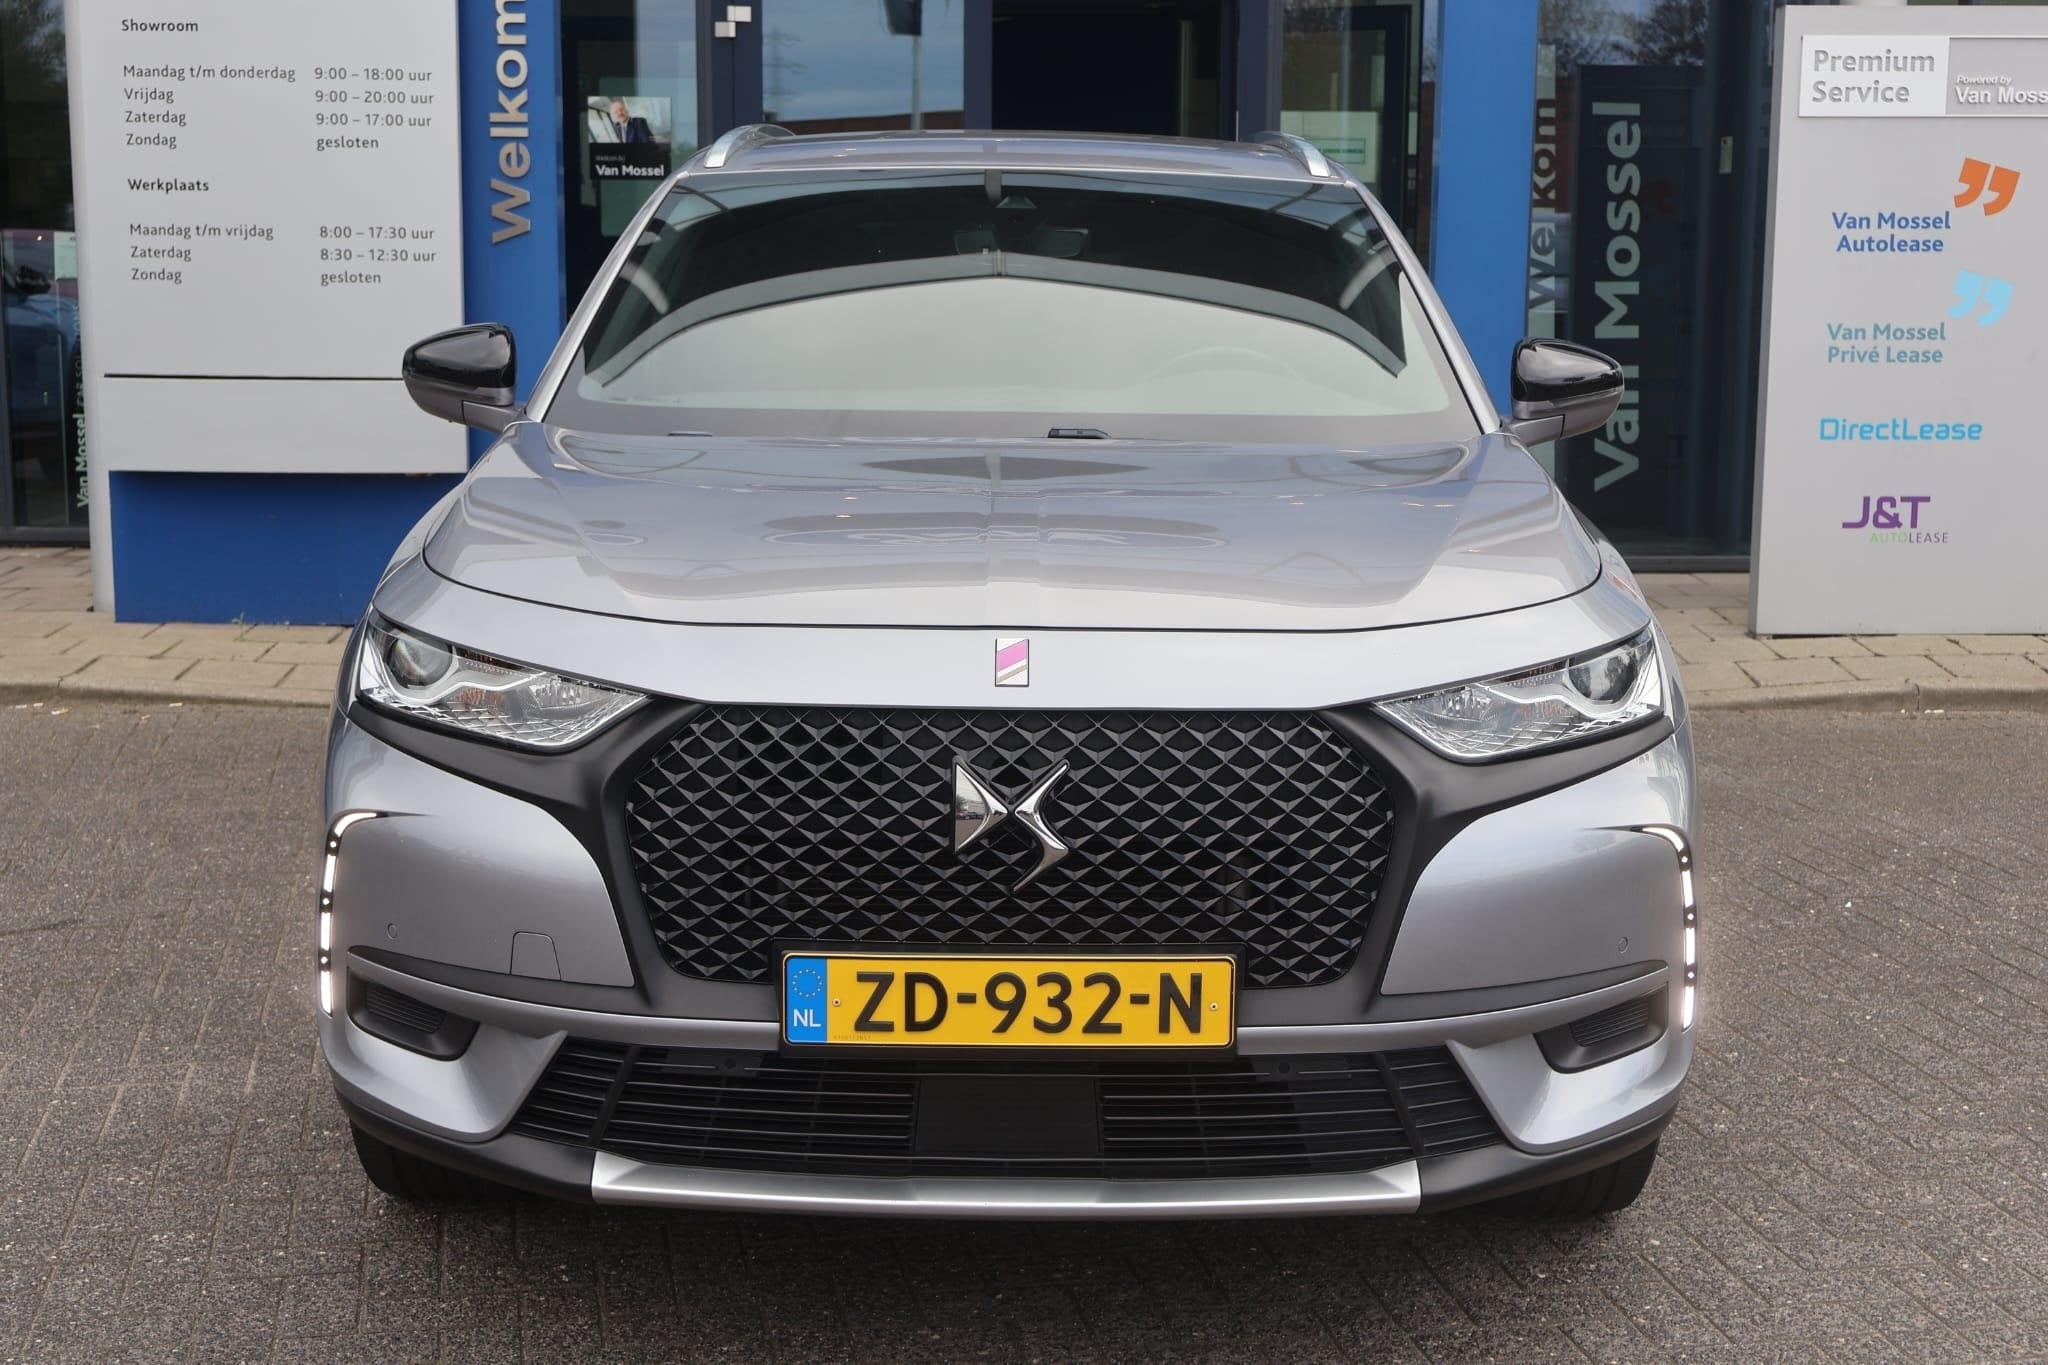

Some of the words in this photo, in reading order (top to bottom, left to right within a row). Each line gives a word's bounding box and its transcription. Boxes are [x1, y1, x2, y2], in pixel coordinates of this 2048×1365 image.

[122, 19, 198, 31] Showroom
[1813, 49, 1935, 72] Premium
[124, 65, 185, 81] Maandag
[190, 65, 215, 78] t/m
[220, 65, 295, 82] donderdag
[315, 67, 346, 79] 9:00
[364, 68, 403, 80] 18:00
[409, 73, 432, 81] uur
[1957, 74, 1999, 85] Powered
[2000, 74, 2013, 86] by
[124, 88, 174, 104] Vrijdag
[315, 90, 347, 102] 9:00
[365, 91, 405, 103] 20:00
[411, 95, 434, 104] uur
[1812, 80, 1910, 103] Service
[1955, 86, 1992, 104] Van
[1997, 86, 2048, 104] Moss
[126, 110, 186, 127] Zaterdag
[316, 113, 348, 125] 9:00
[365, 114, 403, 126] 17:00
[409, 118, 431, 126] uur
[489, 0, 531, 244] Welkom
[127, 133, 176, 149] Zondag
[317, 136, 378, 151] gesloten
[595, 164, 619, 176] Van
[621, 164, 665, 176] Mossel
[128, 178, 208, 194] Werkplaats
[1592, 102, 1641, 339] Mossel
[1832, 212, 1871, 229] Van
[1877, 210, 1951, 229] Mossel
[130, 224, 191, 240] Maandag
[196, 224, 220, 236] t/m
[226, 225, 273, 240] vrijdag
[320, 226, 351, 238] 8:00
[369, 227, 406, 239] 17:30
[412, 230, 434, 239] uur
[1836, 233, 1944, 252] Autolease
[131, 246, 191, 262] Zaterdag
[321, 248, 352, 260] 8:30
[369, 249, 408, 261] 12:30
[413, 253, 436, 261] uur
[132, 268, 182, 284] Zondag
[321, 271, 381, 286] gesloten
[1827, 322, 1866, 340] Van
[1873, 321, 1946, 340] Mossel
[1827, 346, 1880, 363] Privé
[1886, 346, 1944, 363] Lease
[1819, 418, 1983, 441] DirectLease
[72, 413, 88, 472] Mossel
[76, 476, 88, 508] Van
[1842, 496, 1931, 529] J&T
[1870, 531, 1949, 544] AUTOLEASE
[793, 1008, 822, 1028] NL
[854, 971, 1203, 1034] ZD-932-N
